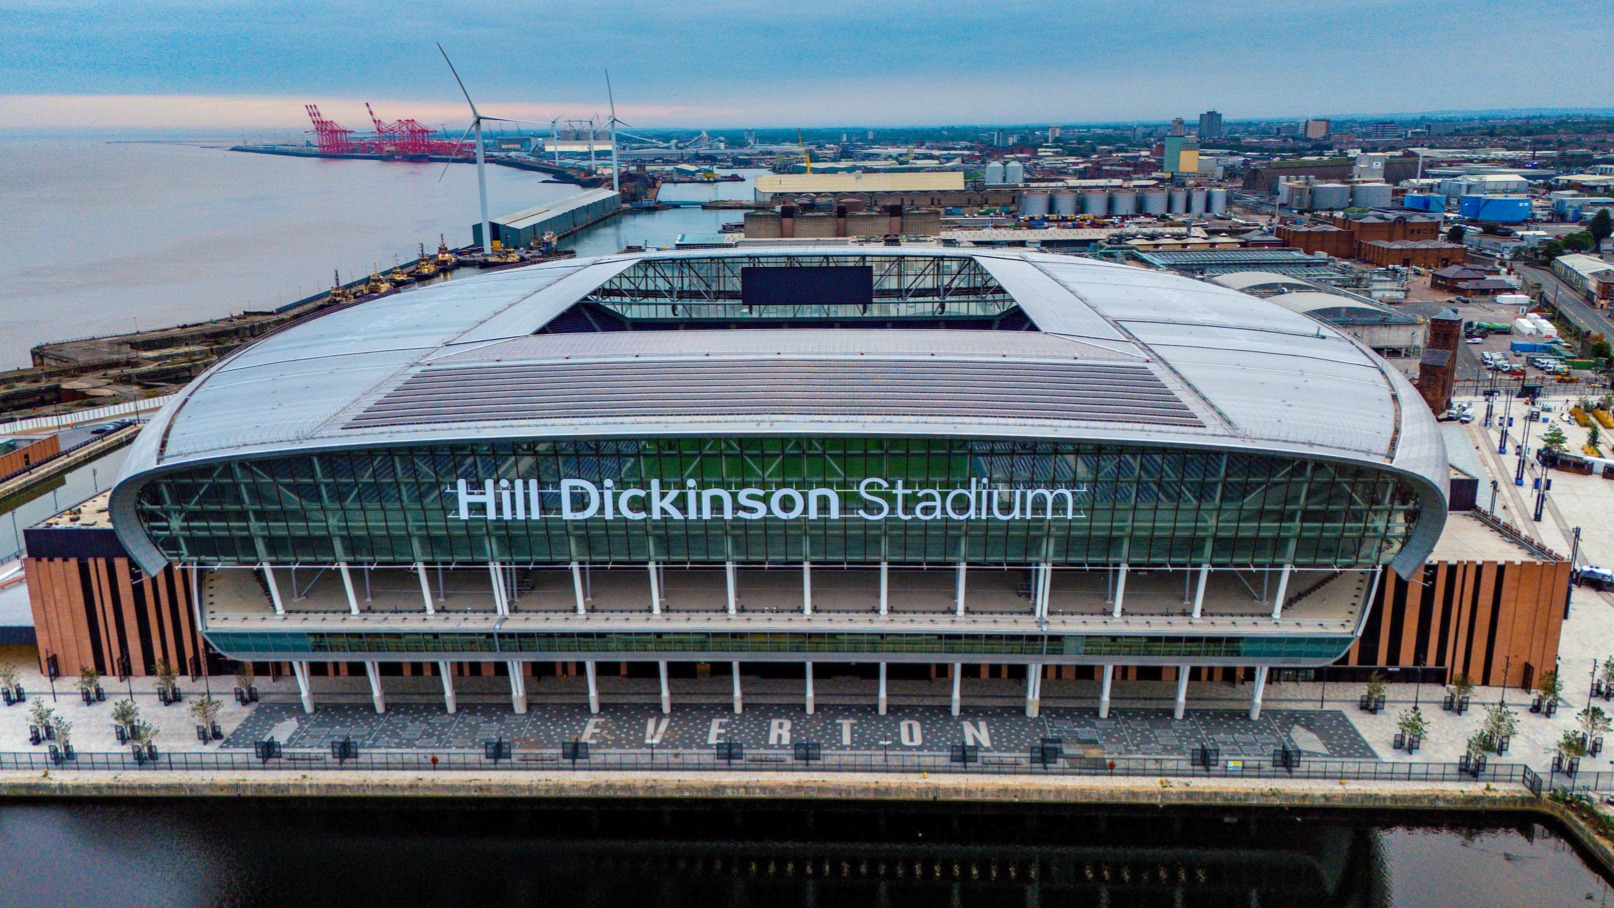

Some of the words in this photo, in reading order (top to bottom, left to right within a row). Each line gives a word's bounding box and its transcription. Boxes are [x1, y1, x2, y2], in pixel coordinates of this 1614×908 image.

[457, 478, 540, 520] Hill
[560, 478, 840, 520] Dickinson
[858, 477, 1073, 520] Stadium
[581, 718, 992, 748] EVERTON
